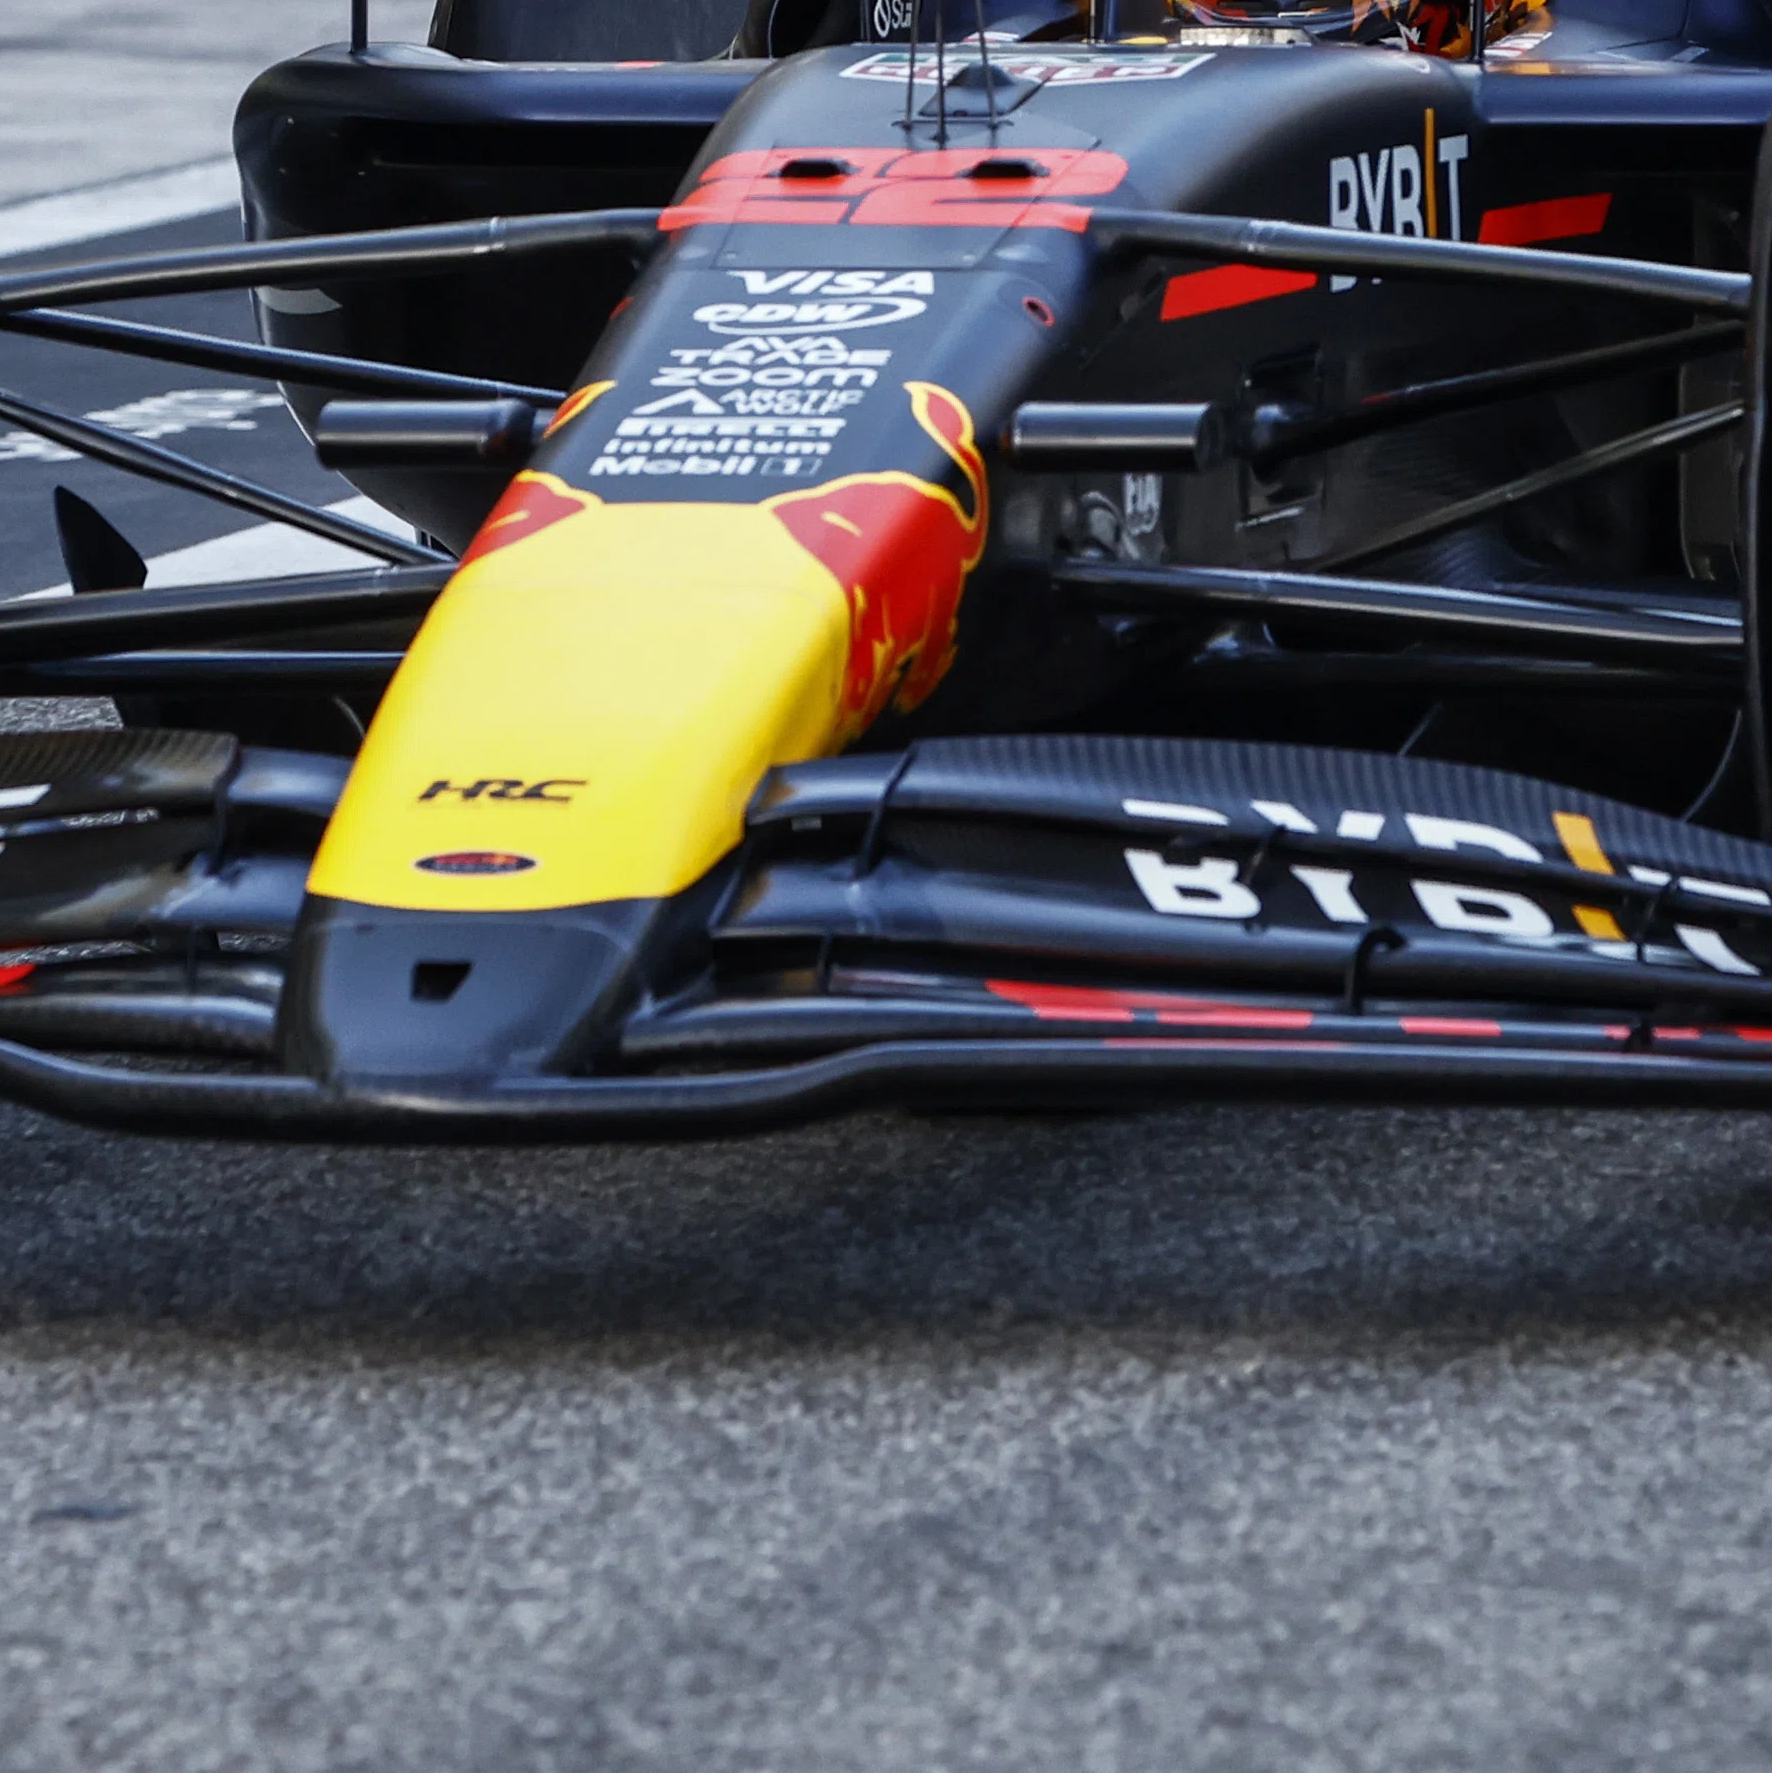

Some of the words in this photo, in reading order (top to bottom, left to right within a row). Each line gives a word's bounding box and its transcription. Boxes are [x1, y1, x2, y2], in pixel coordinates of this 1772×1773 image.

[657, 147, 1129, 234] 22
[726, 269, 934, 295] VISA
[692, 300, 885, 328] CDW
[588, 455, 758, 476] Mobil
[416, 779, 589, 804] HRC
